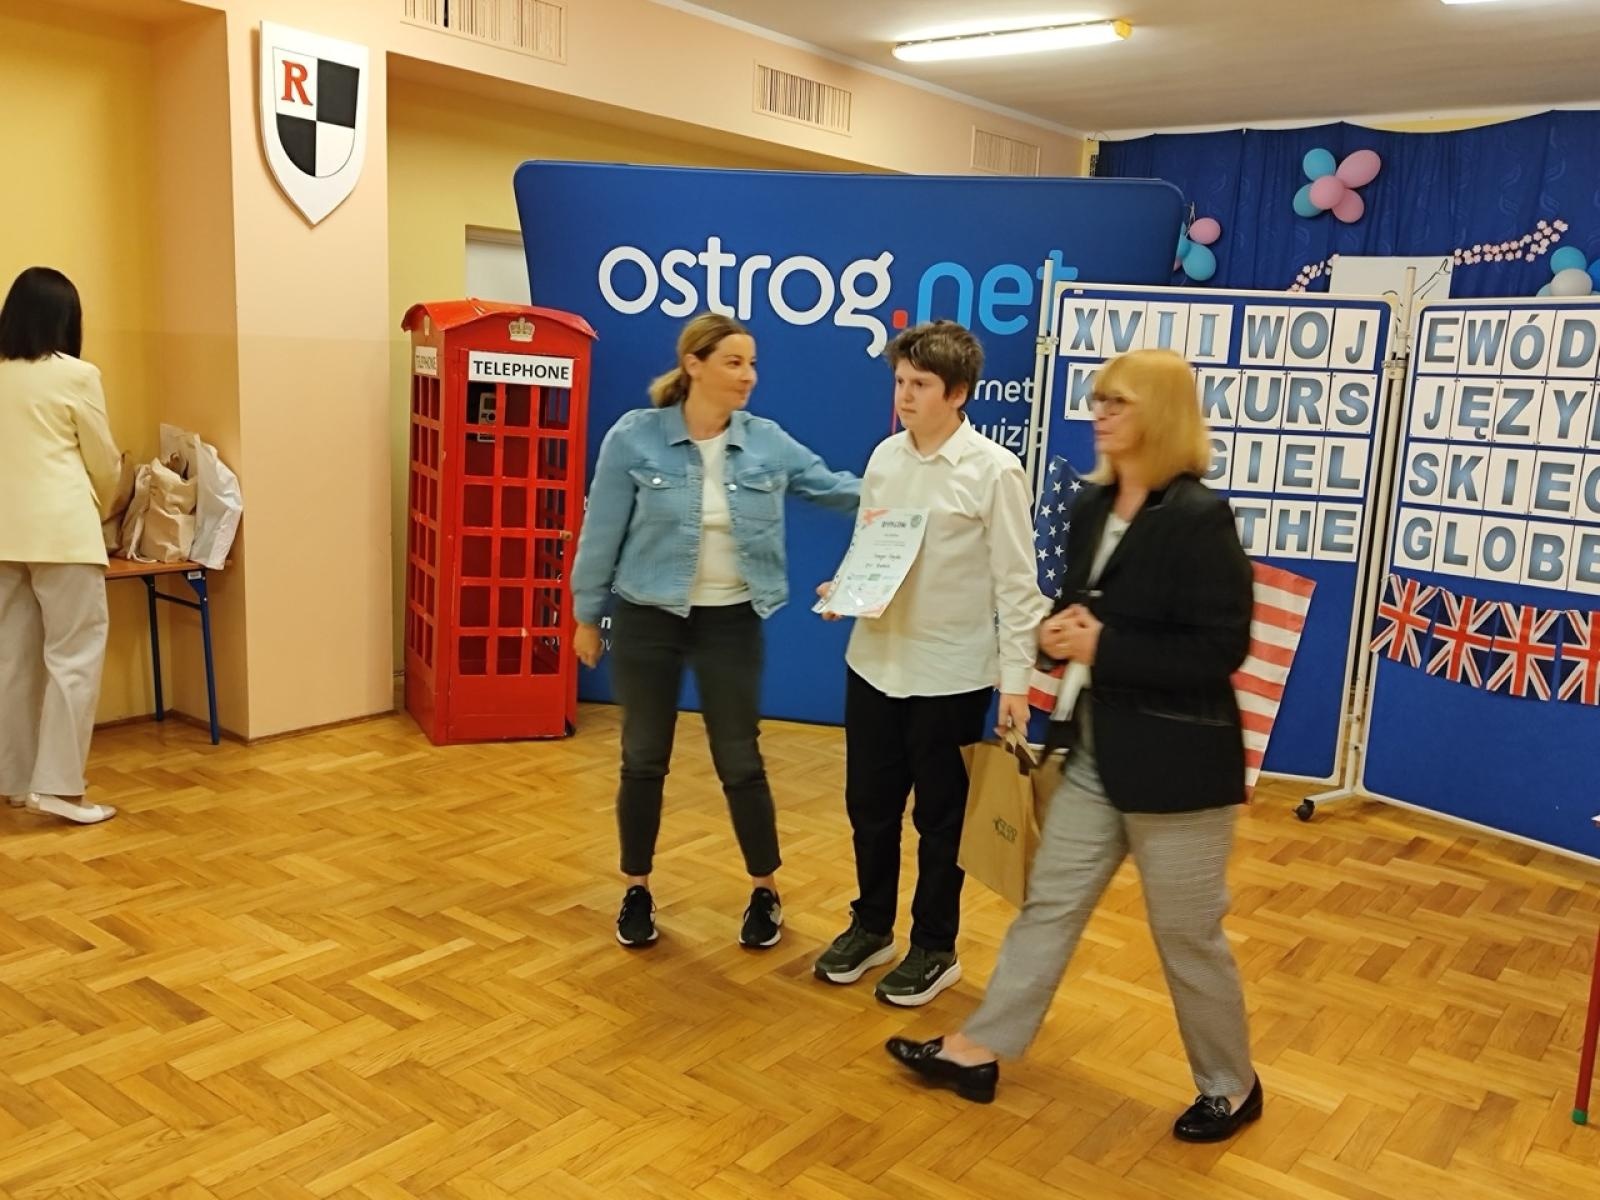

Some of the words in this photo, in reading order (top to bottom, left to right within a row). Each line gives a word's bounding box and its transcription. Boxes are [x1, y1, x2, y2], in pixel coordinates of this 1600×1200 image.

[281, 60, 314, 106] R
[1070, 307, 1219, 358] XVII
[1247, 311, 1368, 364] WOJ
[1424, 313, 1597, 371] EWÓD
[473, 360, 570, 380] TELEPHONE
[974, 377, 1034, 403] rnet
[1070, 369, 1369, 426] KKURS
[1423, 385, 1600, 441] JĘZY
[1203, 438, 1361, 490] GIEL
[1234, 507, 1358, 553] THE
